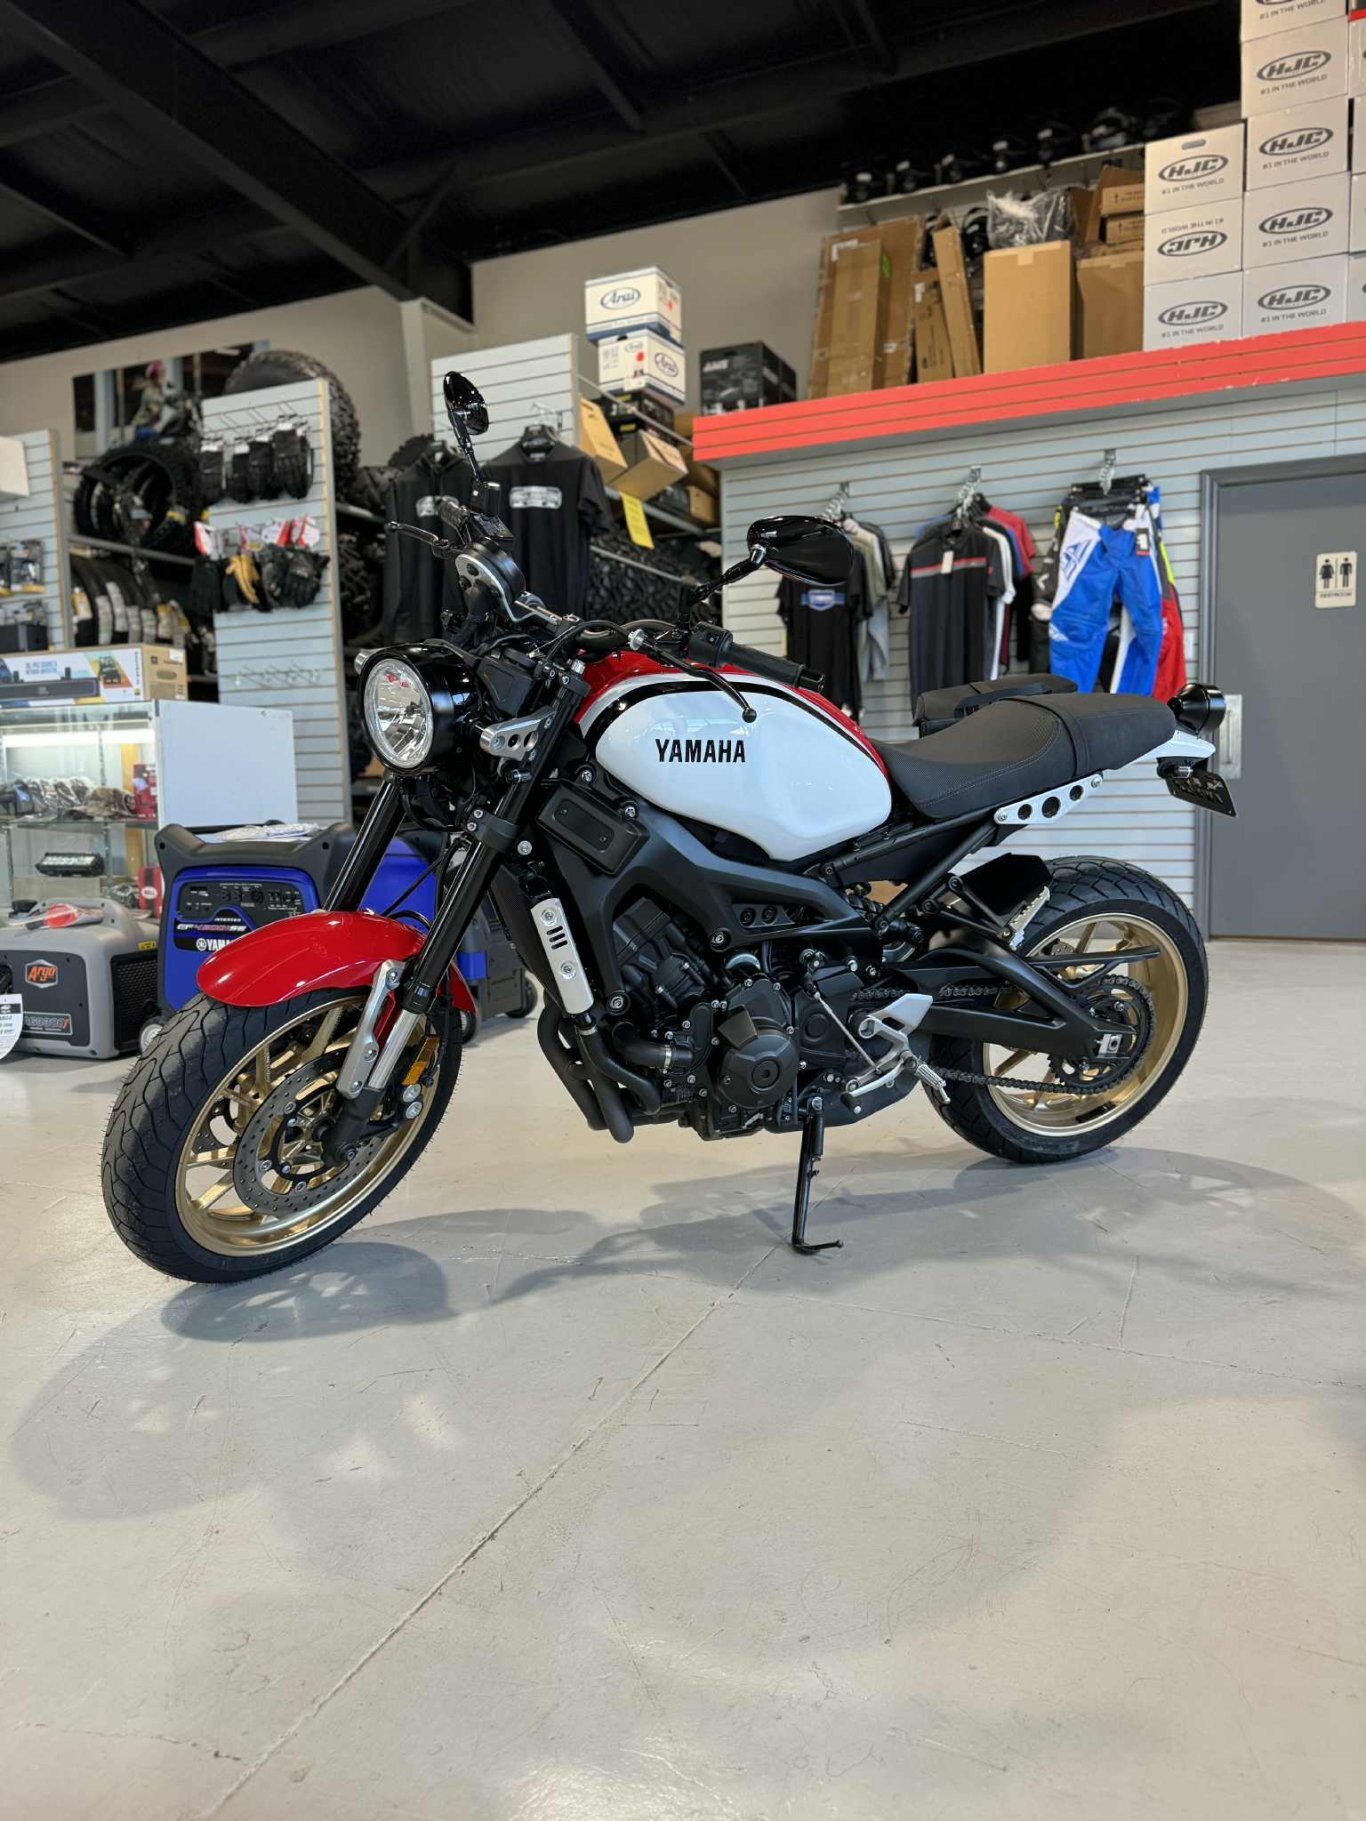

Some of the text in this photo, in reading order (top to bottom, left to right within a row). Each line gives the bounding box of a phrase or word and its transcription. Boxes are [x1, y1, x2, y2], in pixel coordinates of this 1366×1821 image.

[1280, 5, 1295, 14] THE
[1266, 54, 1321, 77] HJC
[1281, 81, 1296, 90] THE
[1298, 74, 1328, 86] WORLD
[1269, 131, 1323, 153] HJC
[1284, 157, 1298, 165] THE
[1300, 151, 1329, 162] WORLD
[1168, 158, 1219, 178] HJC
[1197, 177, 1225, 188] WORLD
[1190, 221, 1204, 229] THE
[1269, 211, 1323, 231] HJC
[1161, 225, 1188, 234] WORLD
[1300, 230, 1329, 241] WORLD
[1167, 234, 1218, 253] HJC
[610, 291, 635, 304] Arai
[1268, 288, 1321, 306] HJC
[1167, 305, 1218, 322] HJC
[1282, 312, 1296, 320] THE
[1298, 308, 1327, 318] WORLD
[1197, 323, 1224, 333] WORLD
[655, 738, 746, 763] YAMAHA
[28, 966, 56, 982] Argo
